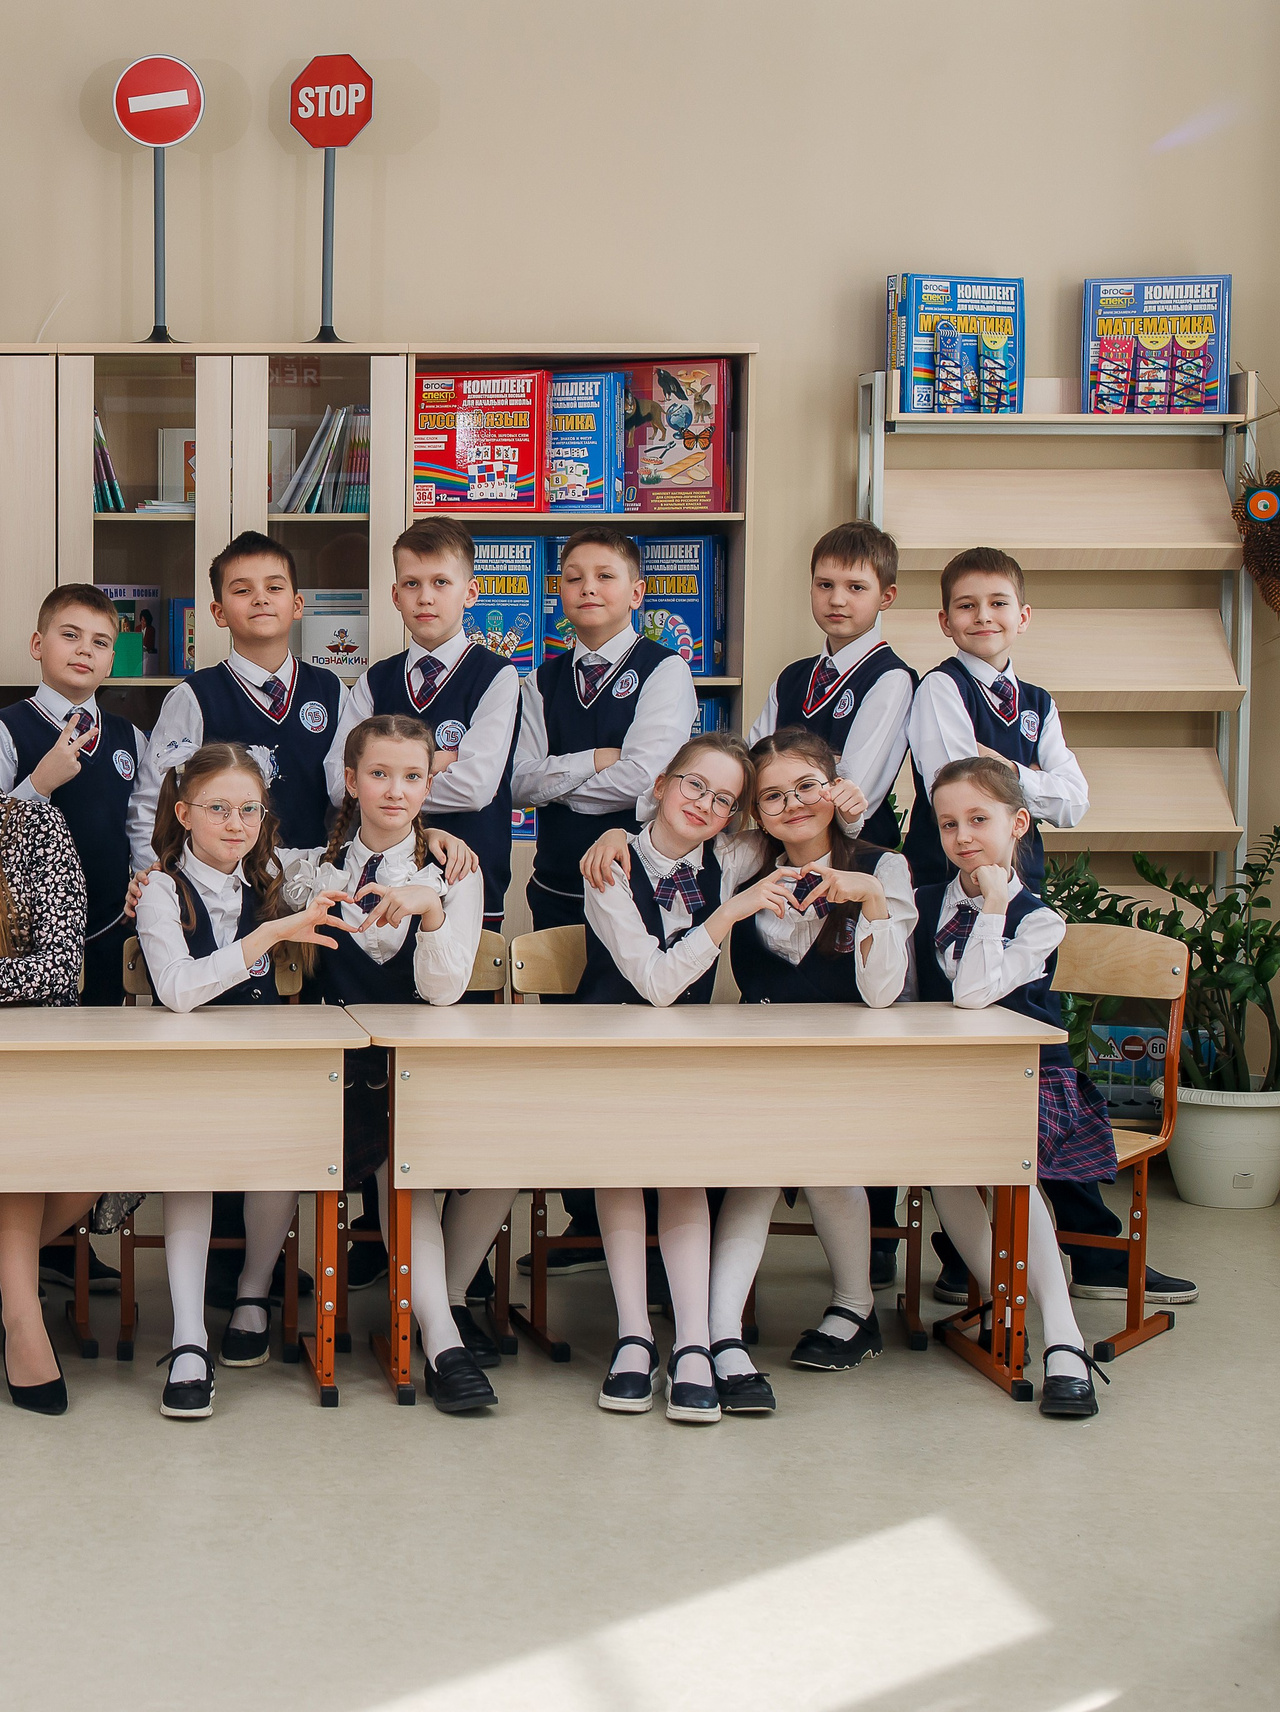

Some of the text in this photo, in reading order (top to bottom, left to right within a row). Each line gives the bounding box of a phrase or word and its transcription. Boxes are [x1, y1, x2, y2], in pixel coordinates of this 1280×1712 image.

[298, 84, 366, 118] STOP
[957, 284, 1015, 300] КОМПЛЕКТ
[1144, 284, 1219, 300] КОМПЛЕКТ
[920, 314, 1012, 335] МАМАТИКА
[1098, 316, 1214, 335] МАТЕМАТИКА
[463, 379, 533, 394] КОМПЛЕКТ
[917, 394, 931, 402] 24
[485, 413, 528, 427] ЯЗЫК
[416, 492, 432, 500] 364
[133, 589, 158, 598] ПОСОБИЕ
[312, 655, 368, 665] ПОЗНАЙКИН
[620, 680, 630, 689] 15
[308, 711, 322, 723] 15
[1026, 718, 1036, 731] 15
[445, 730, 459, 742] 15
[1152, 1043, 1165, 1054] 60
